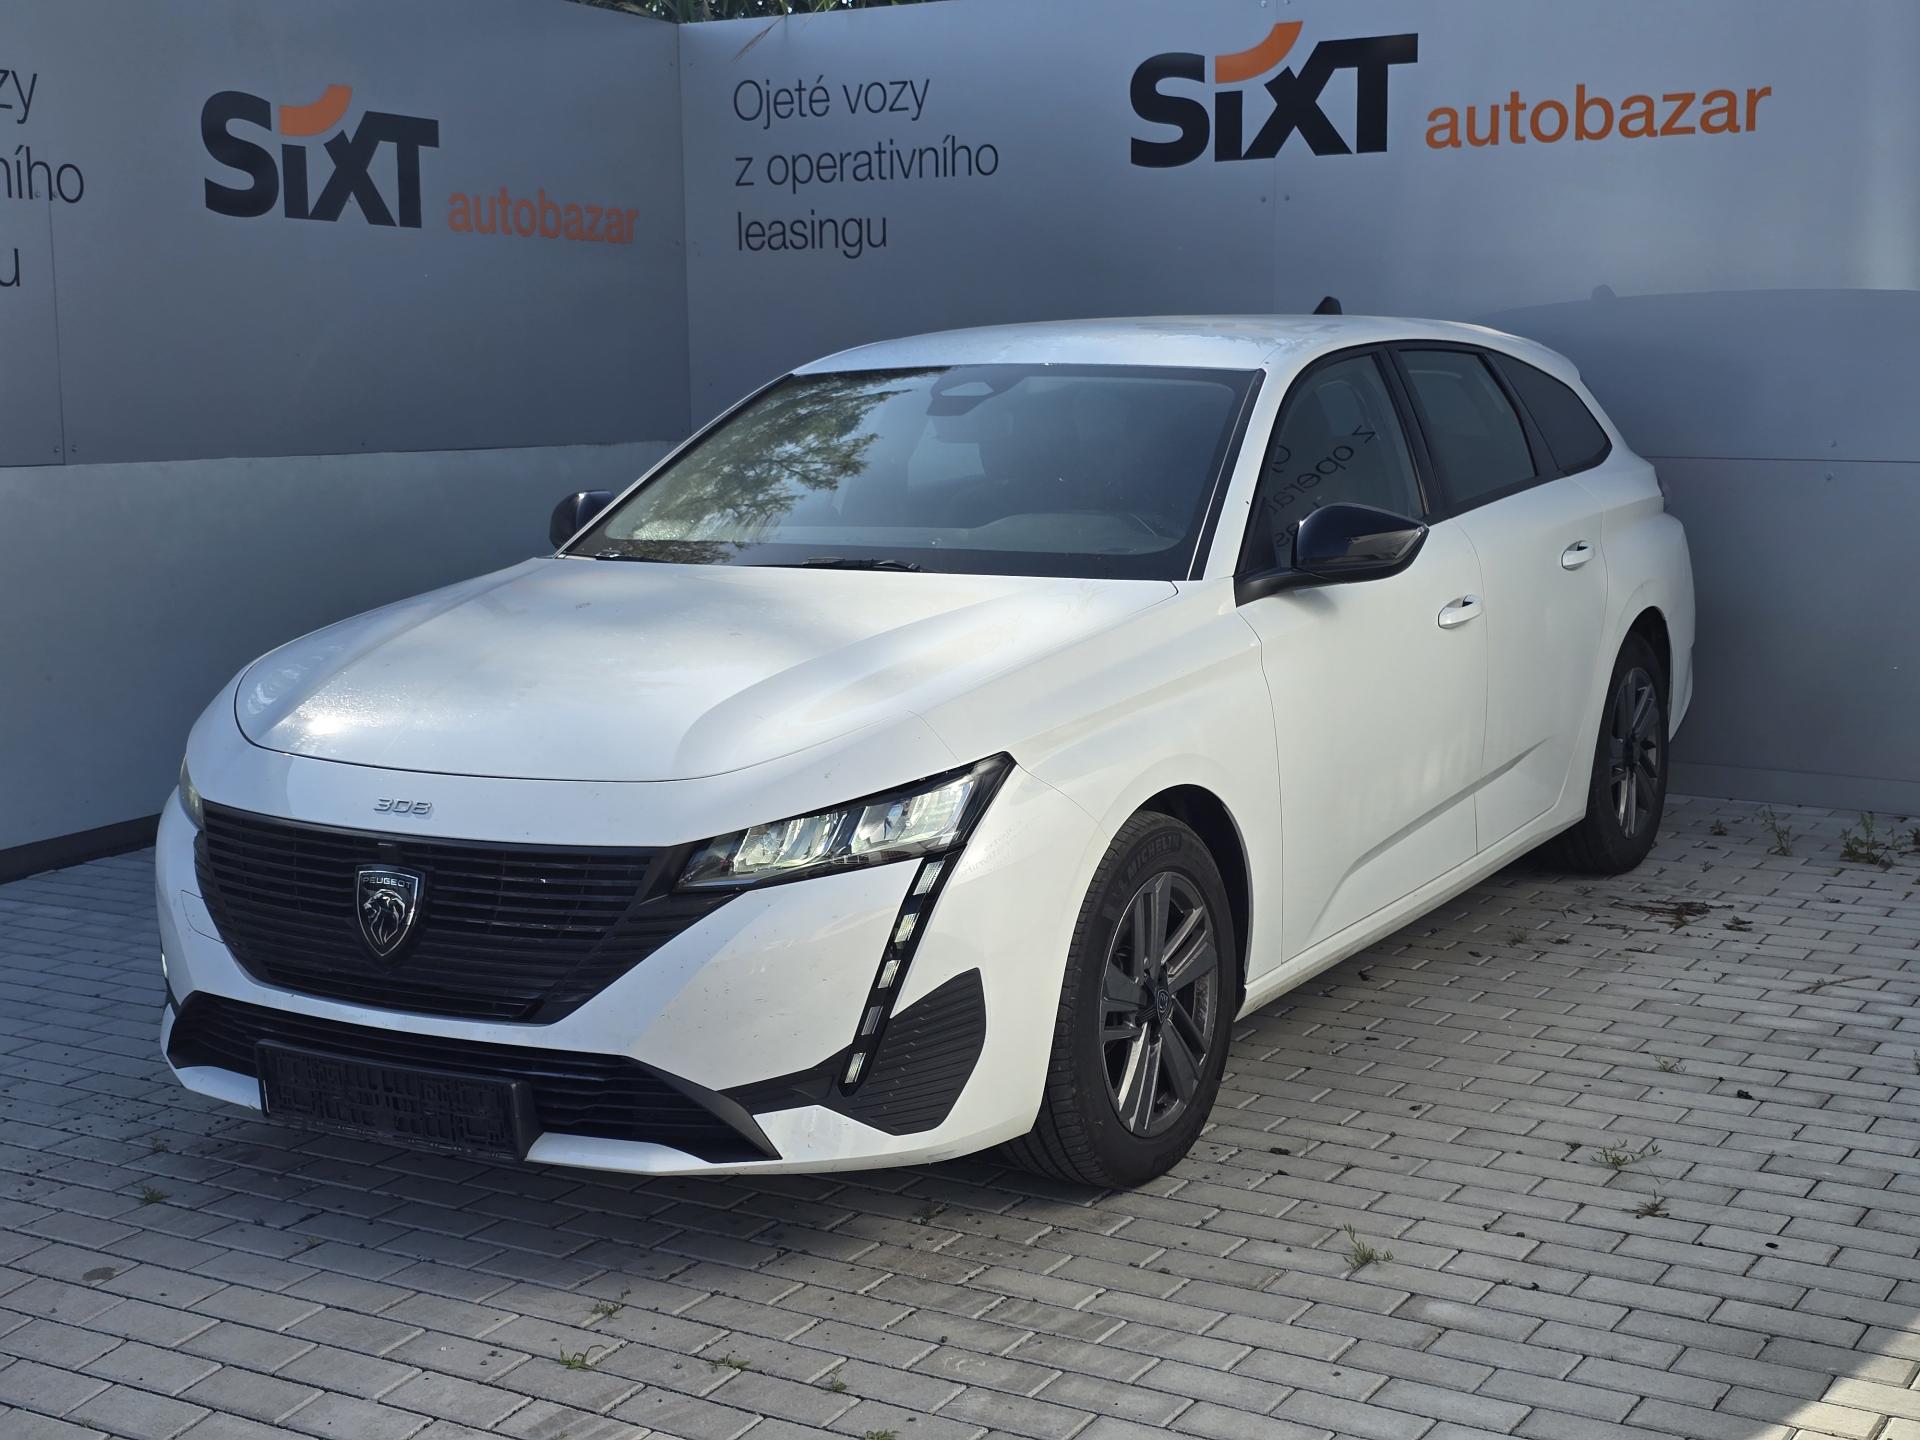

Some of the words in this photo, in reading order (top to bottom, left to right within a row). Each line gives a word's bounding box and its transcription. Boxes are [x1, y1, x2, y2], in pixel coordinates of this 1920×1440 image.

[733, 75, 830, 130] Ojeté
[842, 79, 930, 121] vozy
[1425, 84, 1771, 149] autobazar
[735, 156, 754, 188] z
[767, 135, 999, 194] operativního
[448, 187, 640, 245] autobazar
[737, 209, 887, 259] leasingu
[374, 798, 432, 815] 308
[362, 877, 412, 888] PEUGEOT
